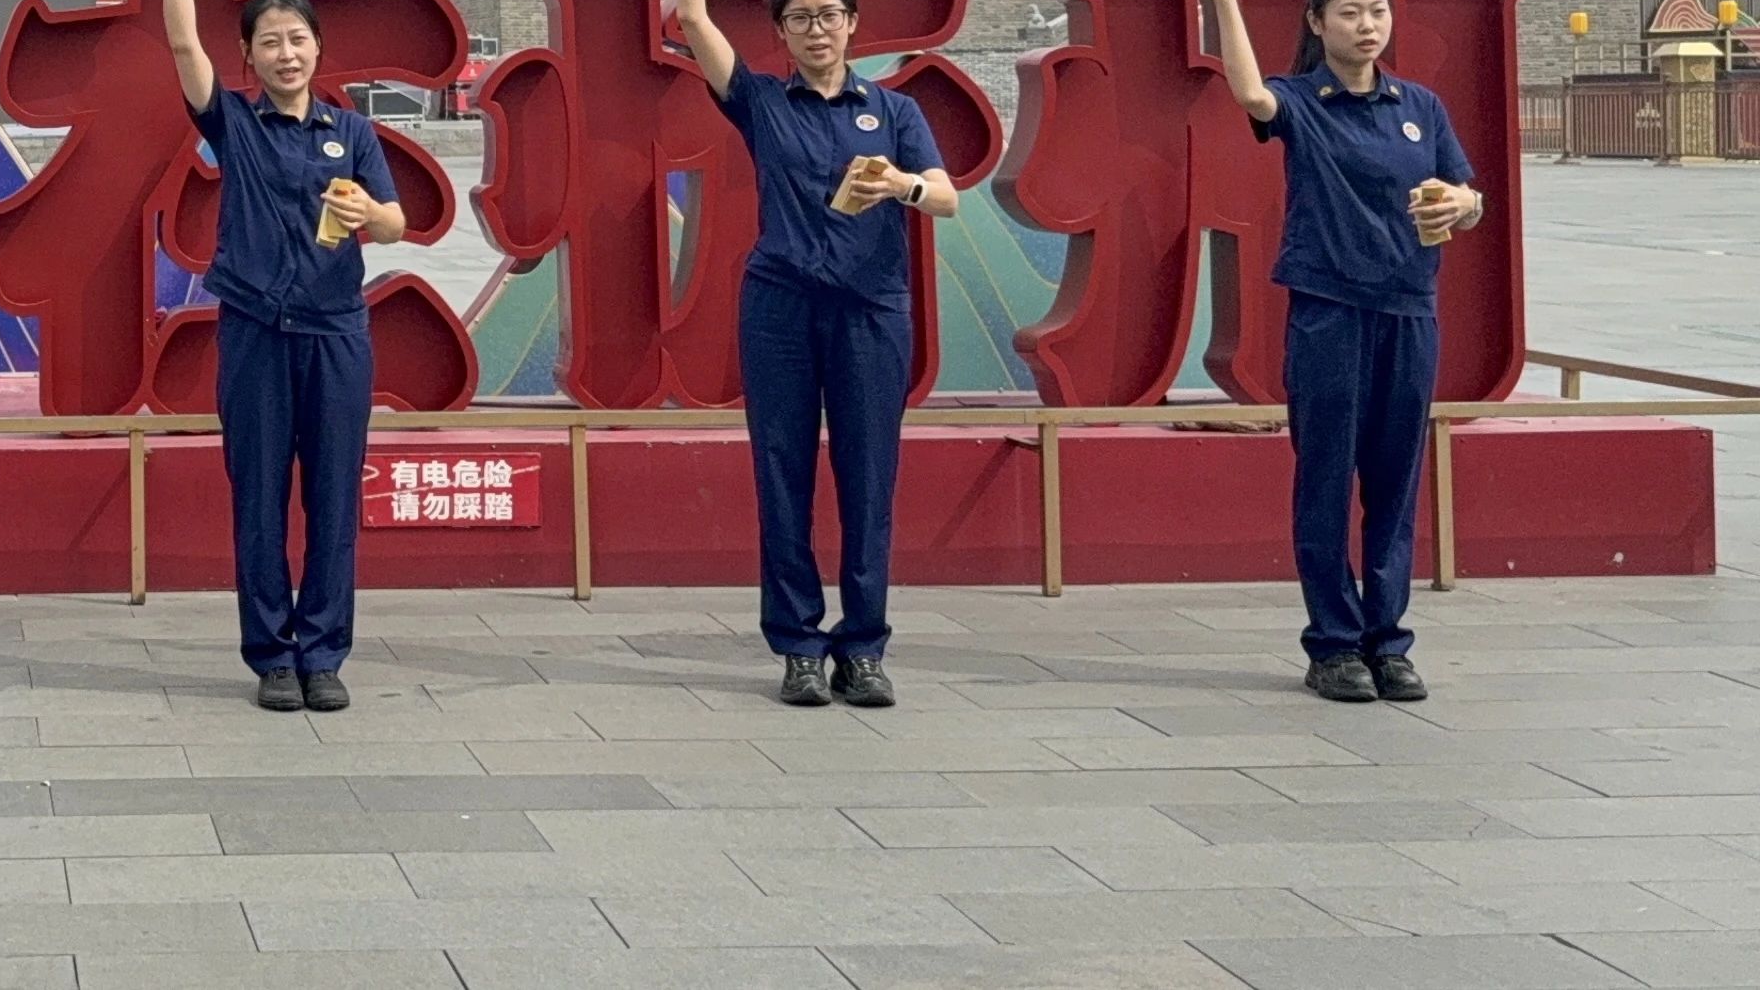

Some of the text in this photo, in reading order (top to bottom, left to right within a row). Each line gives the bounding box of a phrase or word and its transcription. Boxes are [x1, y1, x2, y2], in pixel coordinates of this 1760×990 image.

[390, 459, 513, 489] 有电危险
[390, 491, 514, 521] 请勿踩踏
